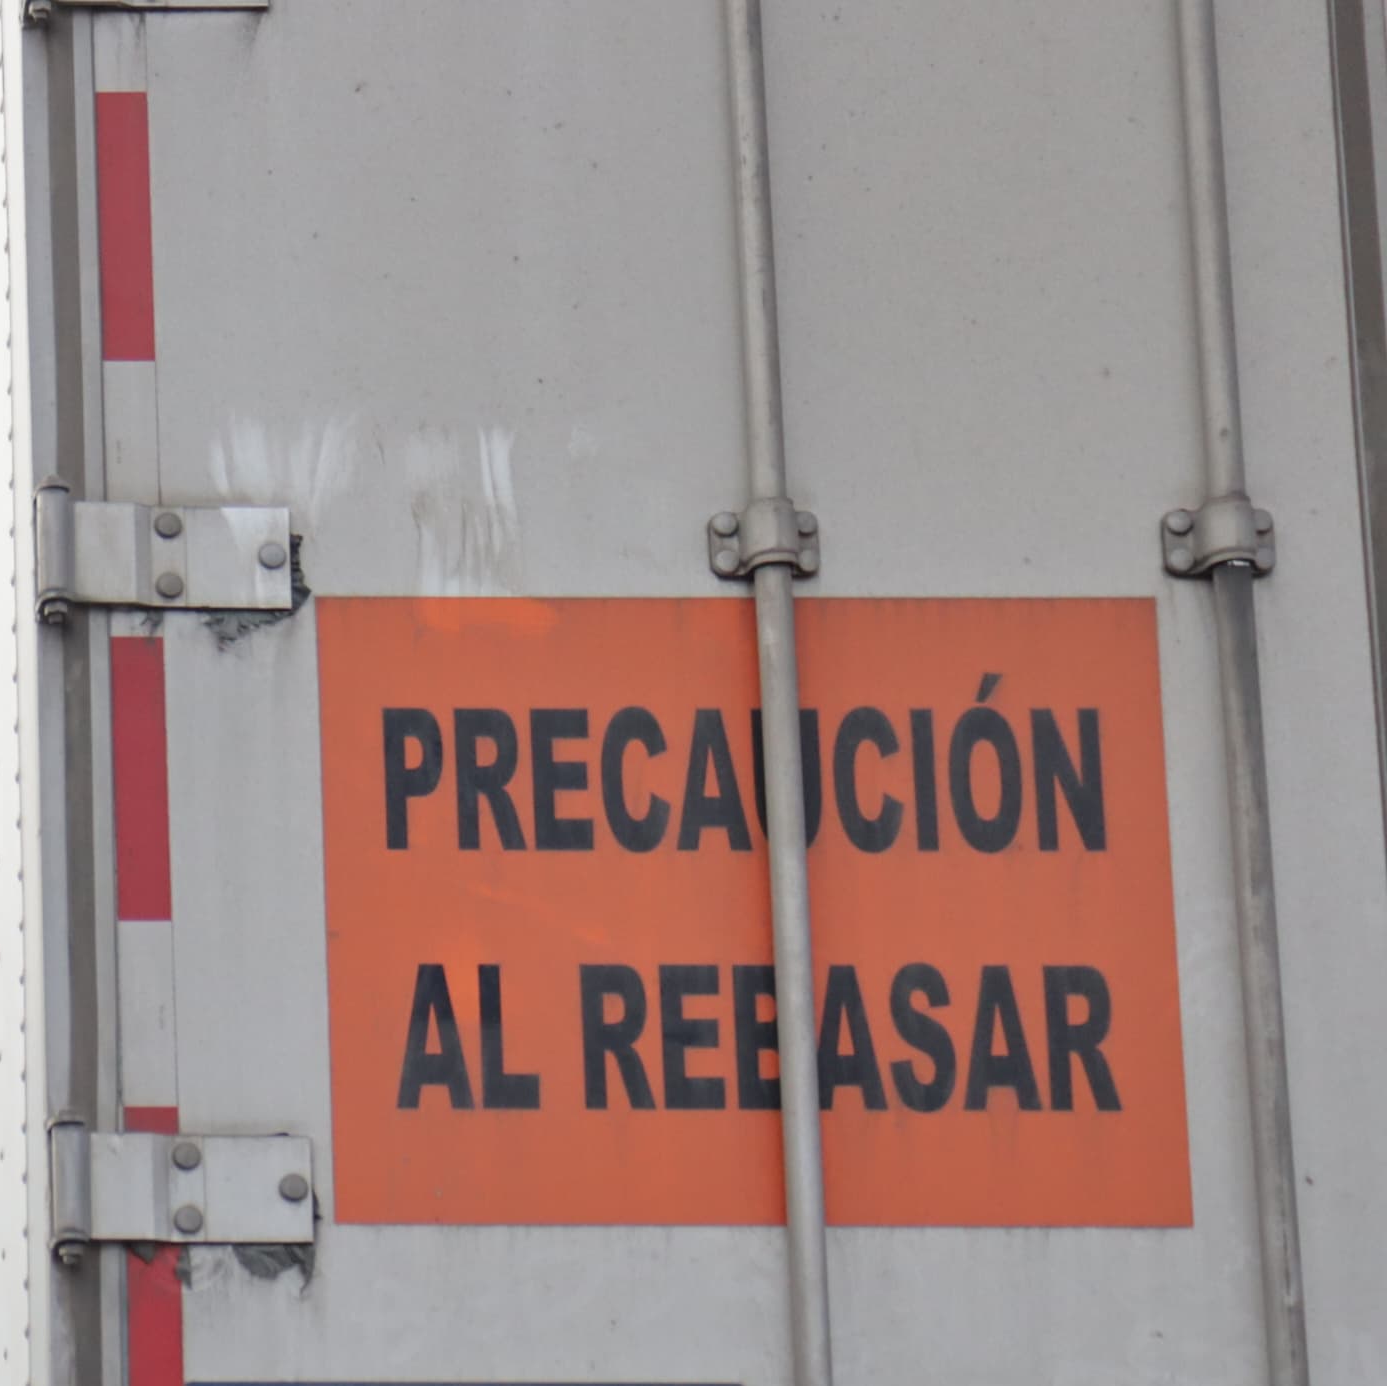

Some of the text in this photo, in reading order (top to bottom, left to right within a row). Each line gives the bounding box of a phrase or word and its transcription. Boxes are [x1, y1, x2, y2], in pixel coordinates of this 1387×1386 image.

[381, 671, 1107, 853] PRECAUCIÓN
[396, 963, 1122, 1113] AL REBASAR
